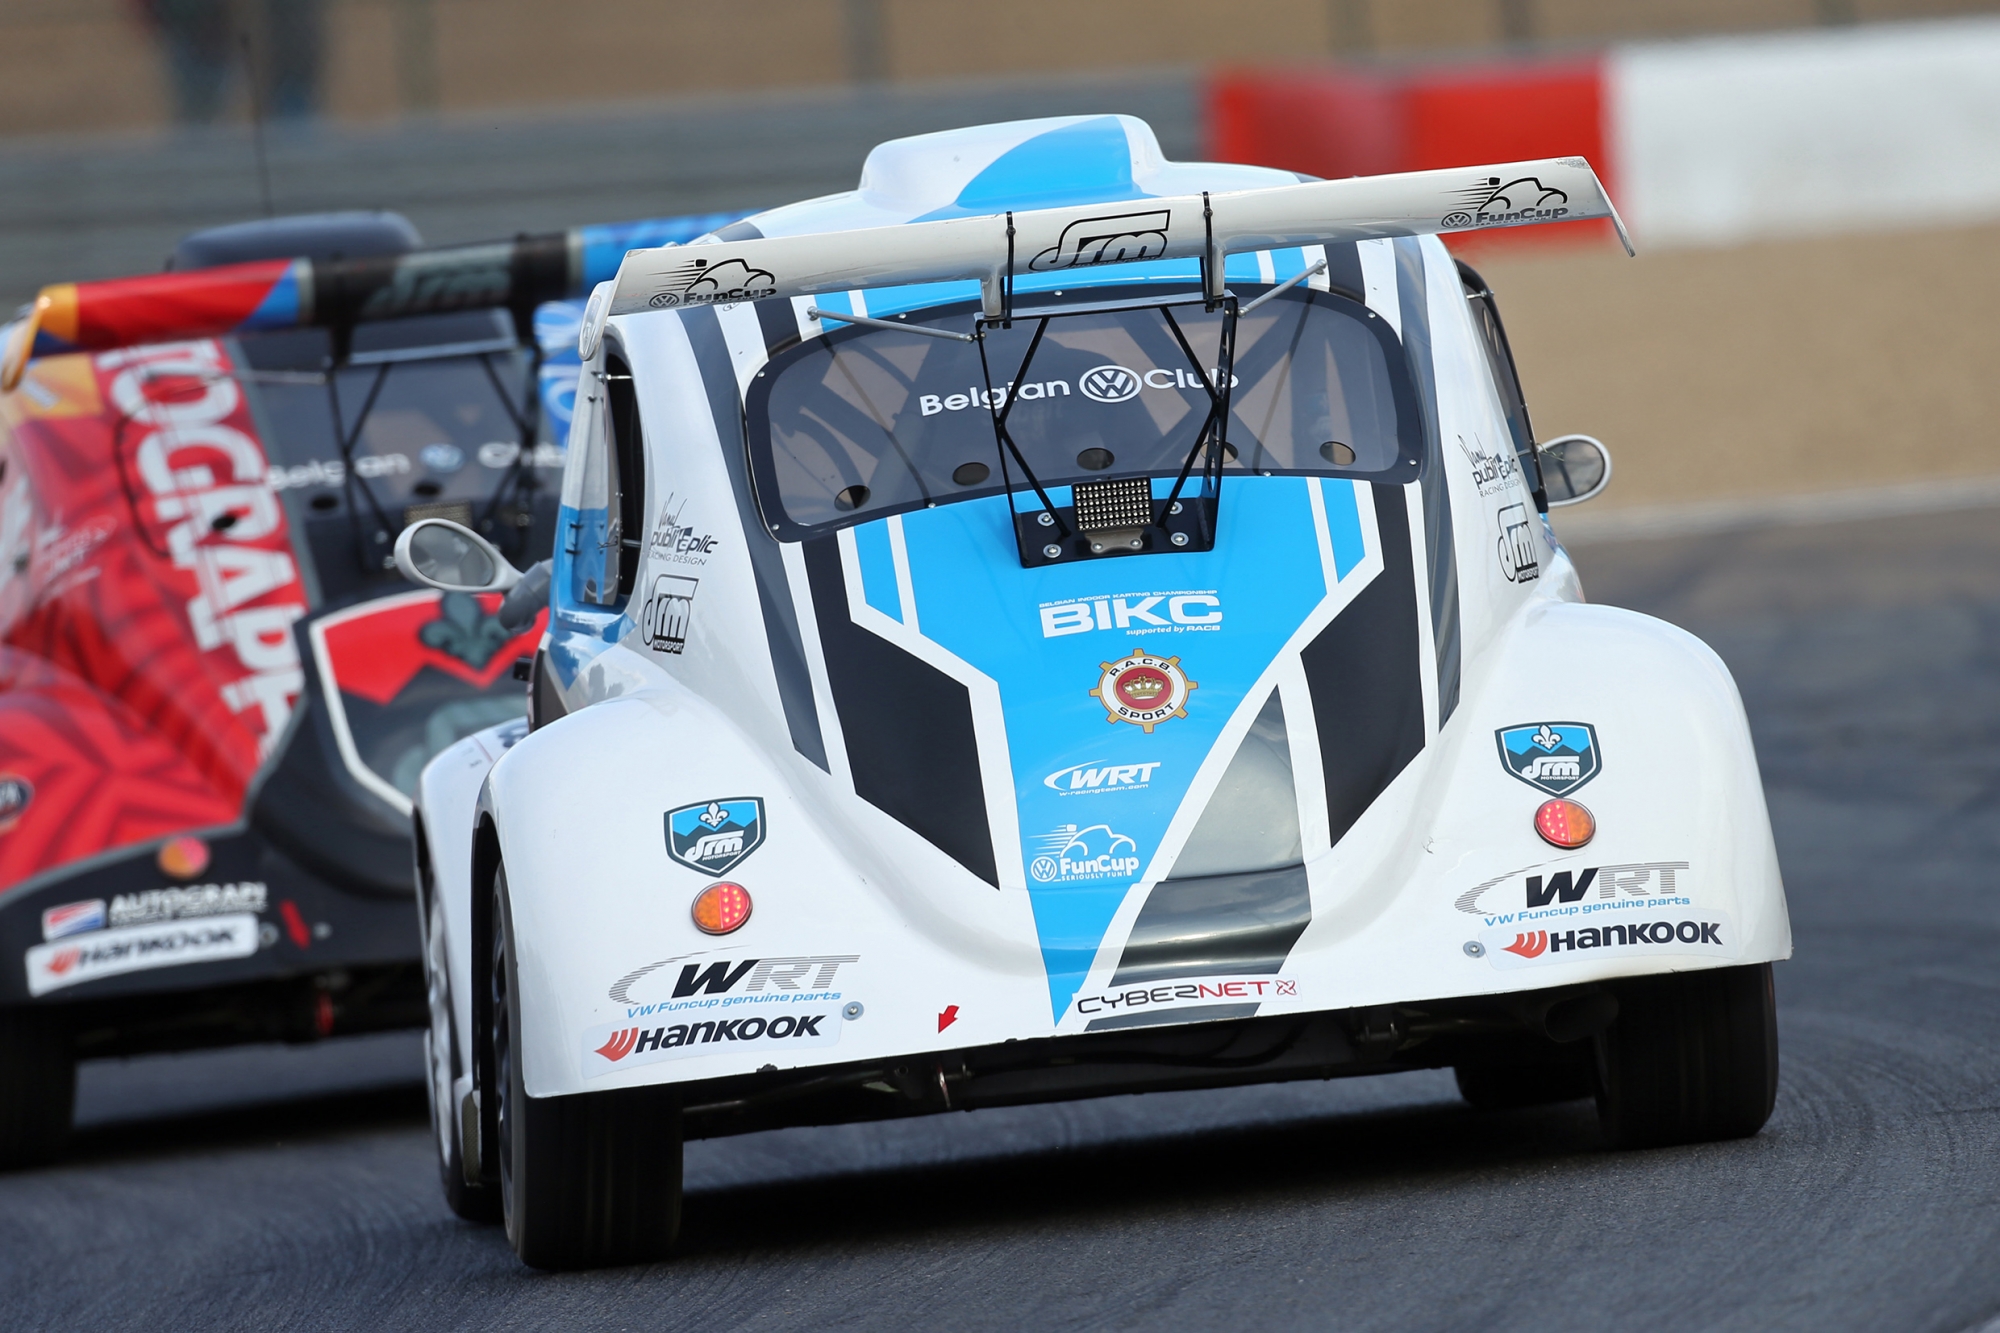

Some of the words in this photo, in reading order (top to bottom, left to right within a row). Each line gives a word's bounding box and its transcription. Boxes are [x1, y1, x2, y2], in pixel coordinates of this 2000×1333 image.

[1476, 207, 1568, 223] FunCup
[683, 288, 777, 304] FunCup
[267, 453, 410, 491] Belgan
[672, 554, 708, 566] DESIGN
[1039, 598, 1076, 609] BELGIAN
[1077, 594, 1111, 603] INDOOR
[1112, 591, 1151, 599] KARTING
[1152, 589, 1218, 597] CHAMPIONSHIP
[1039, 595, 1223, 638] BIKC
[1126, 626, 1171, 637] supported
[1173, 625, 1185, 634] by
[1117, 702, 1175, 721] SPORT
[1070, 761, 1162, 790] WRT
[1059, 784, 1149, 797] w-racingteam.com
[702, 850, 741, 862] MOTORSPORT
[1060, 854, 1140, 876] FunCup
[1061, 871, 1104, 882] SERIOUSLY
[1107, 870, 1127, 879] FUN!
[1526, 861, 1690, 908] WRT
[1484, 913, 1515, 927] VW
[1518, 906, 1579, 922] Funcup
[1582, 899, 1645, 914] genuine
[1648, 896, 1691, 908] parts
[671, 955, 861, 999] WRT
[627, 1004, 657, 1019] VW
[657, 999, 720, 1014] Funcup
[721, 994, 792, 1008] genuine
[792, 991, 842, 1004] parts
[1077, 981, 1271, 1014] CYBERNET
